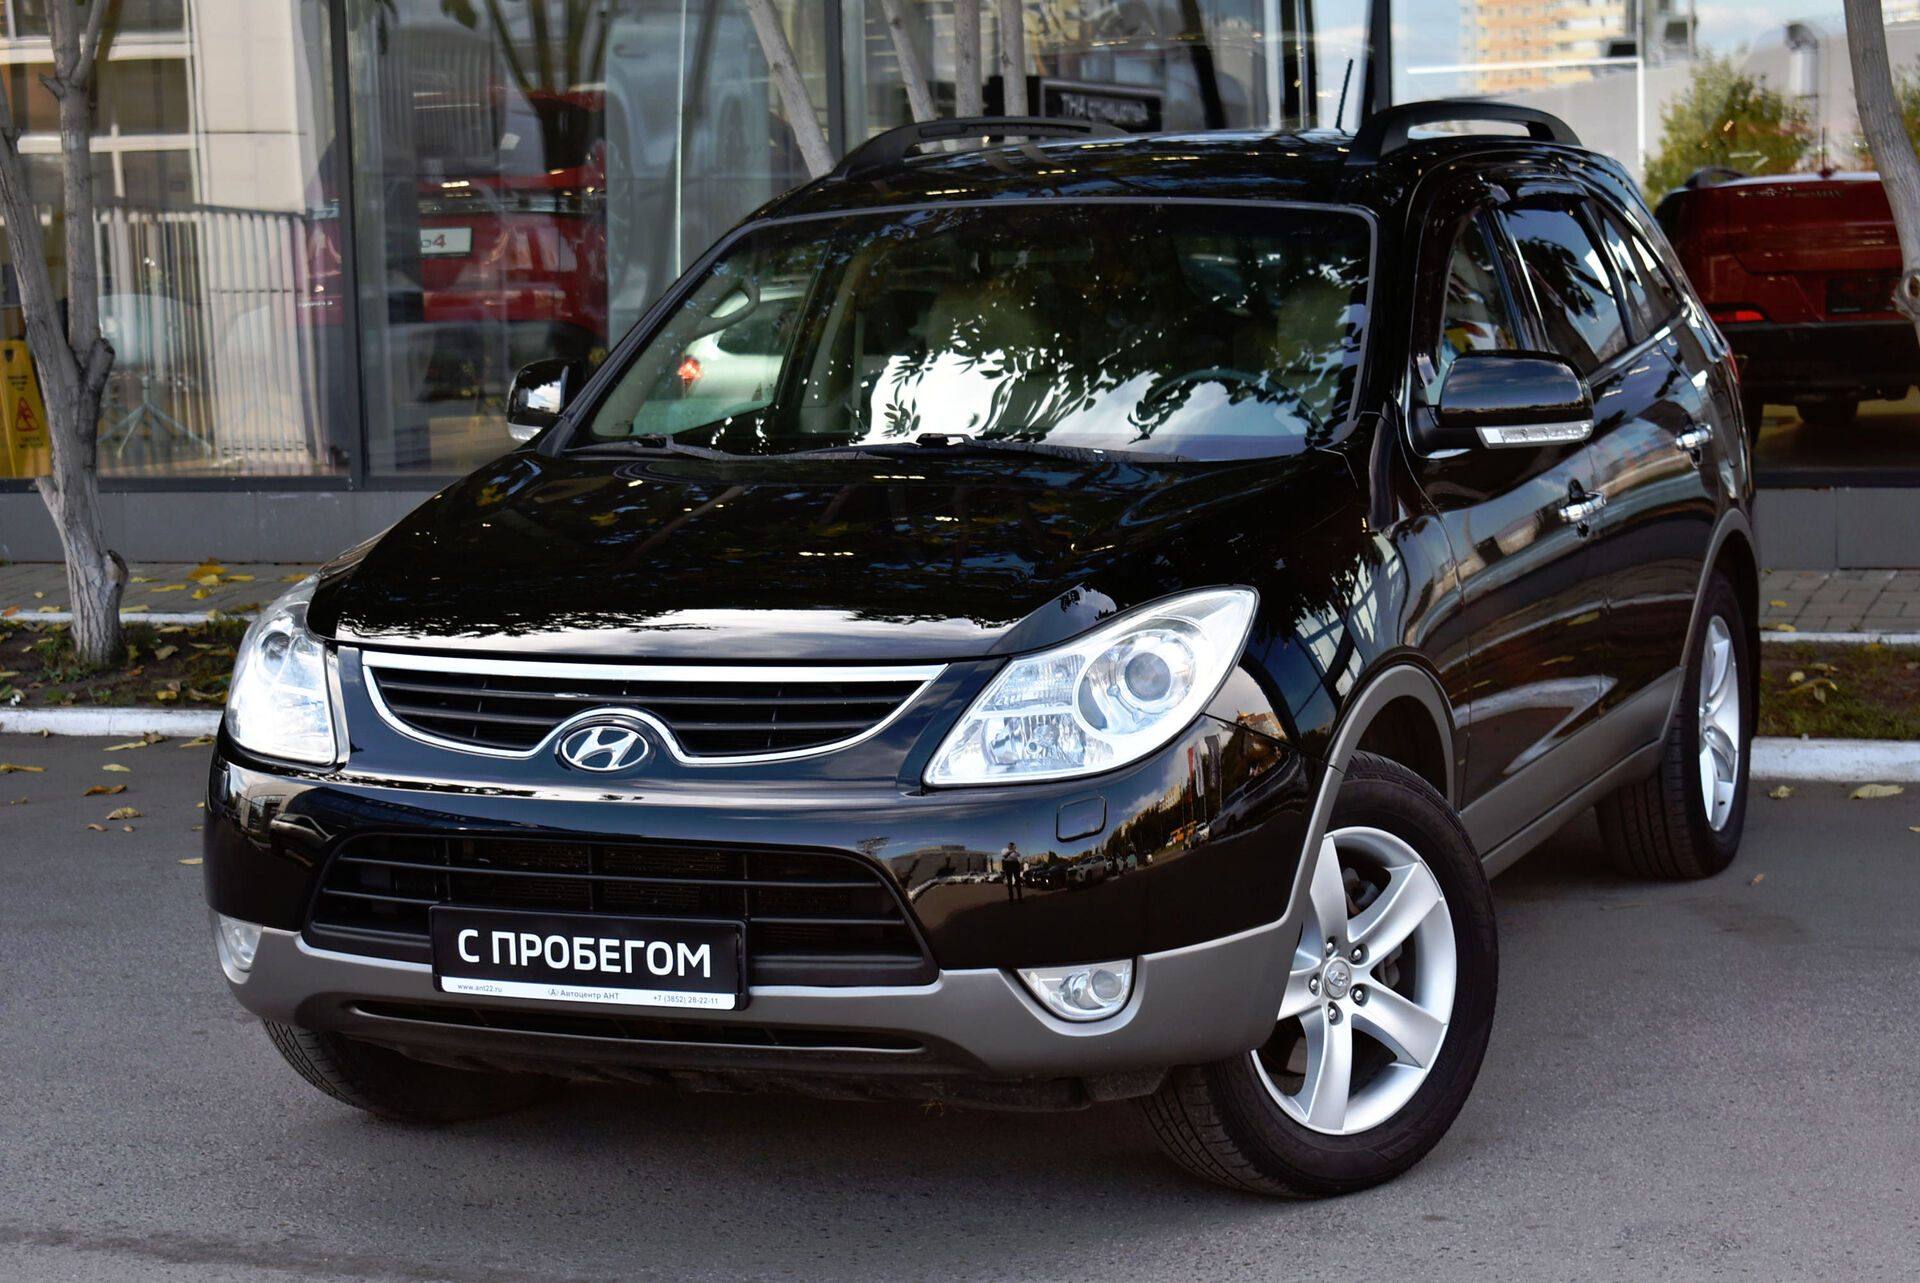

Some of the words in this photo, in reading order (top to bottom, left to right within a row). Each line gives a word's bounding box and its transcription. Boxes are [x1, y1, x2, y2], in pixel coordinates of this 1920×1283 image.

[457, 928, 480, 963] С
[491, 930, 711, 978] ПРОБЕГОМ
[457, 983, 503, 993] www.ant22.ru
[560, 989, 601, 1000] Автоцентр
[603, 992, 619, 1000] АНТ
[663, 995, 686, 1005] (3852)
[688, 997, 719, 1005] 28-22-11
